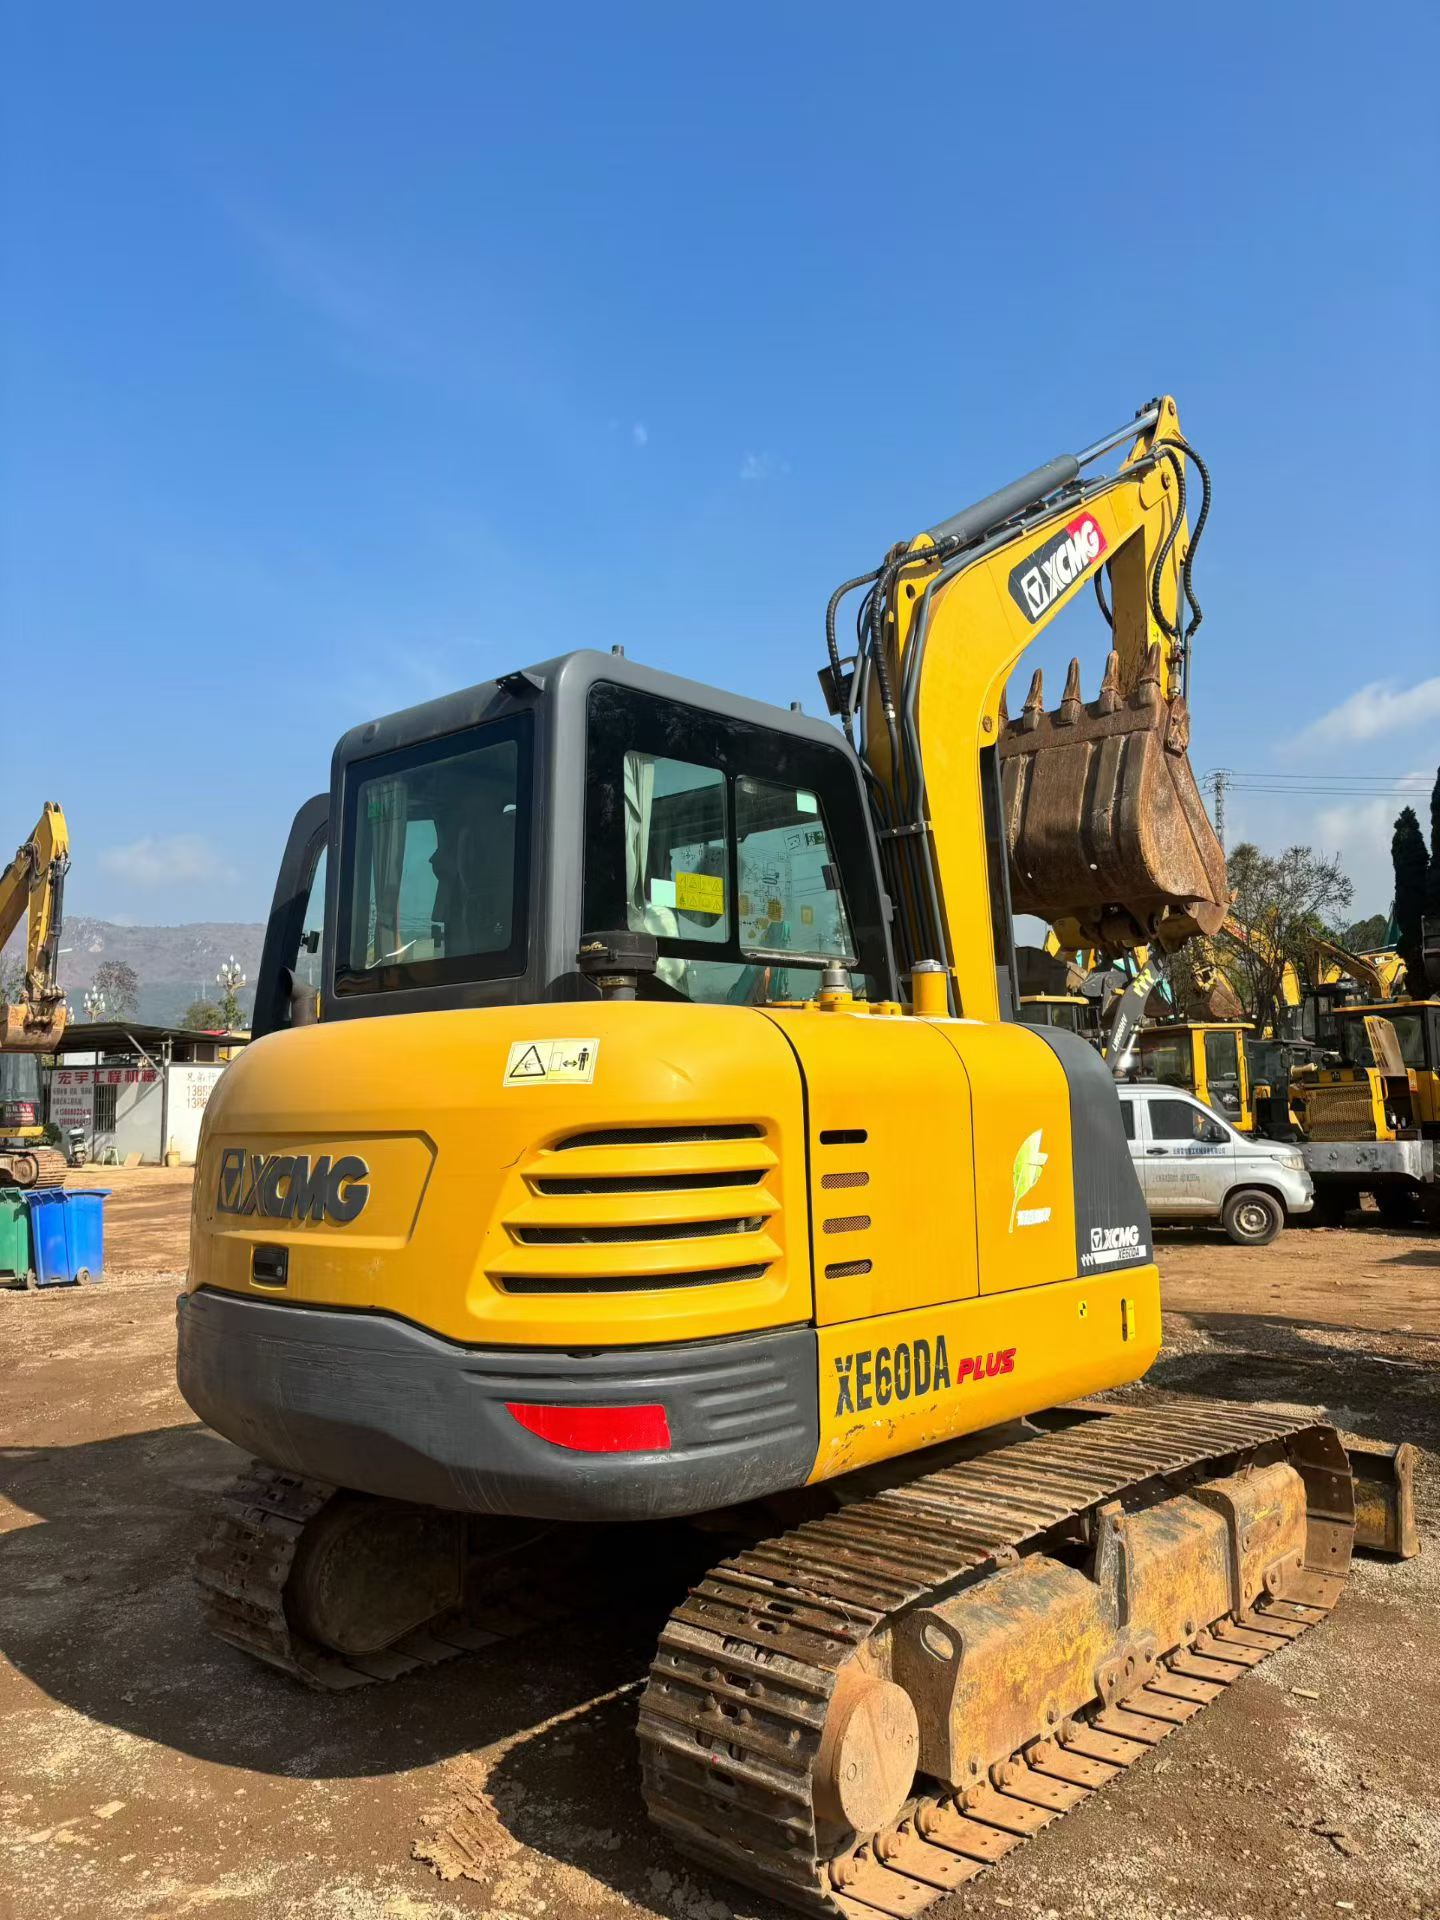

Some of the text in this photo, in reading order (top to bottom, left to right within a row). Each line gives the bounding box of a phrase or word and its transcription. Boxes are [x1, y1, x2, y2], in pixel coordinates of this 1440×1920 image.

[1041, 520, 1099, 602] XCMG
[241, 1154, 371, 1222] XCMG
[1102, 1225, 1139, 1249] XCMG
[834, 1335, 1017, 1418] XE60DA PLUS
